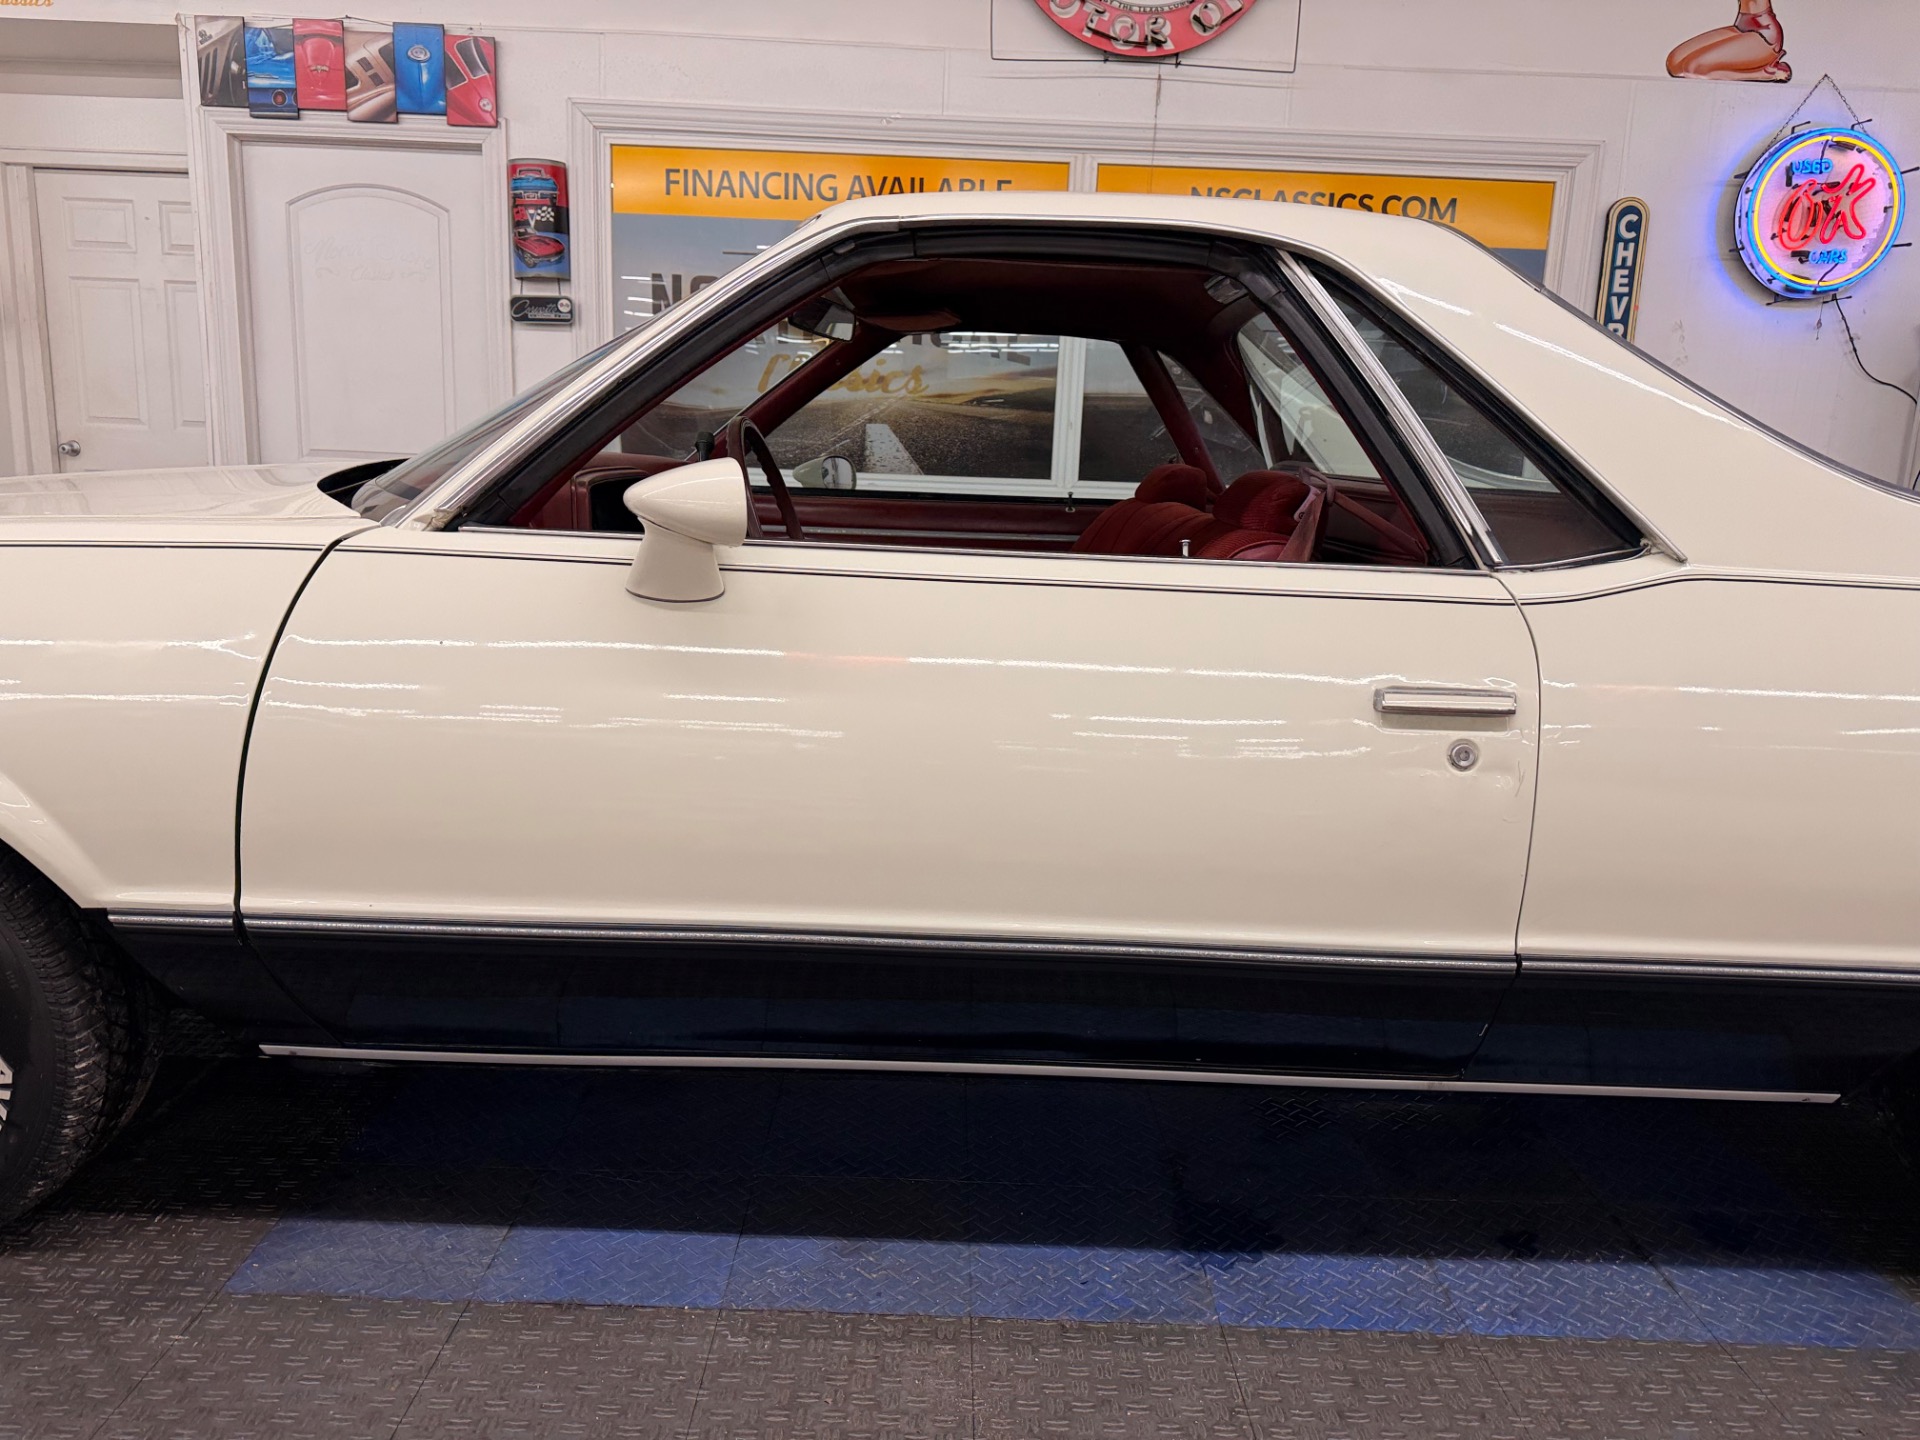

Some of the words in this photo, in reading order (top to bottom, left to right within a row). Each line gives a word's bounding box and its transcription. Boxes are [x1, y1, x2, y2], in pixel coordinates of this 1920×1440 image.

[1118, 3, 1133, 11] THE
[1791, 158, 1833, 174] USED
[664, 168, 838, 201] FINANCING
[1778, 163, 1876, 251] OK
[1808, 249, 1848, 264] CARS
